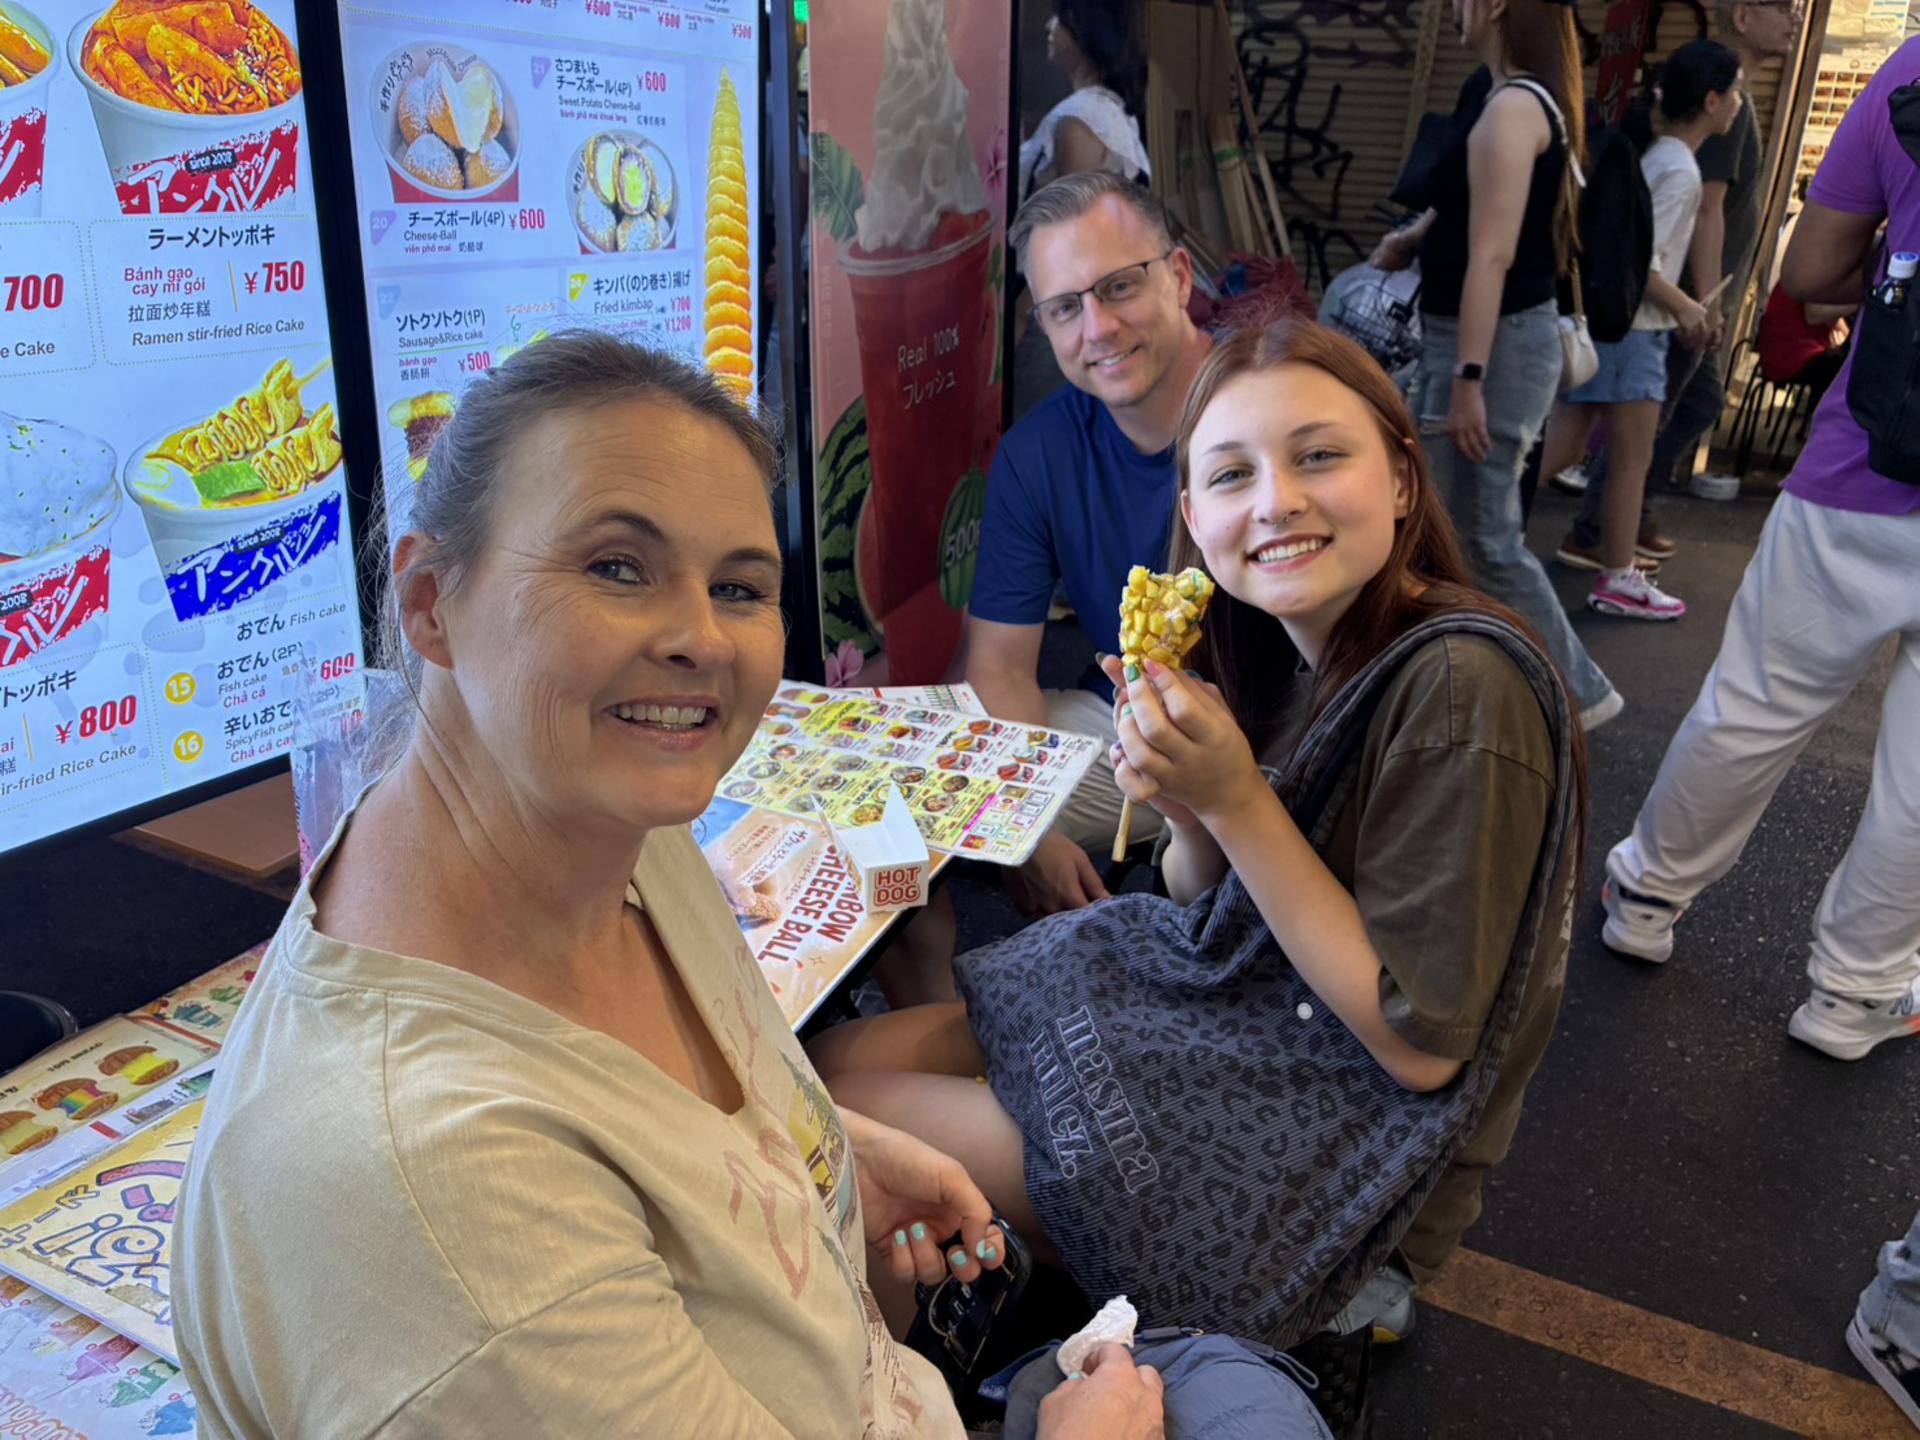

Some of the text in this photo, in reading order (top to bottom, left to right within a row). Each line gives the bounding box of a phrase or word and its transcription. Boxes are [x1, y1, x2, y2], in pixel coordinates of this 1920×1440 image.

[555, 58, 600, 76] さつまいも
[372, 216, 388, 229] 20
[408, 210, 505, 229] チーズボール(4P)
[148, 223, 276, 250] ラーメントッポキ
[404, 230, 457, 241] Cheese-Ball
[124, 267, 163, 282] Bánh
[4, 273, 64, 312] 700
[132, 284, 159, 297] cay
[128, 300, 211, 323] 拉面炒年糕
[594, 301, 618, 315] Fried
[396, 308, 486, 333] ソトクソトク(1P)
[132, 319, 305, 346] Ramen stir-fried Rice Cake
[399, 329, 483, 349] Sausage&Rice cake
[15, 341, 55, 357] Cake
[898, 323, 960, 372] Real 100%
[903, 370, 956, 410] フレッシュ
[945, 519, 981, 570] 500
[290, 602, 347, 626] Fish cake
[236, 613, 286, 642] おでん
[0, 669, 77, 708] トッポキ
[169, 677, 191, 698] 15
[218, 673, 268, 695] Fish cake
[177, 735, 200, 757] 16
[0, 744, 137, 796] ir-fried Rice Cake
[876, 866, 921, 888] HOT
[875, 885, 921, 906] DOG
[757, 918, 814, 962] BALL
